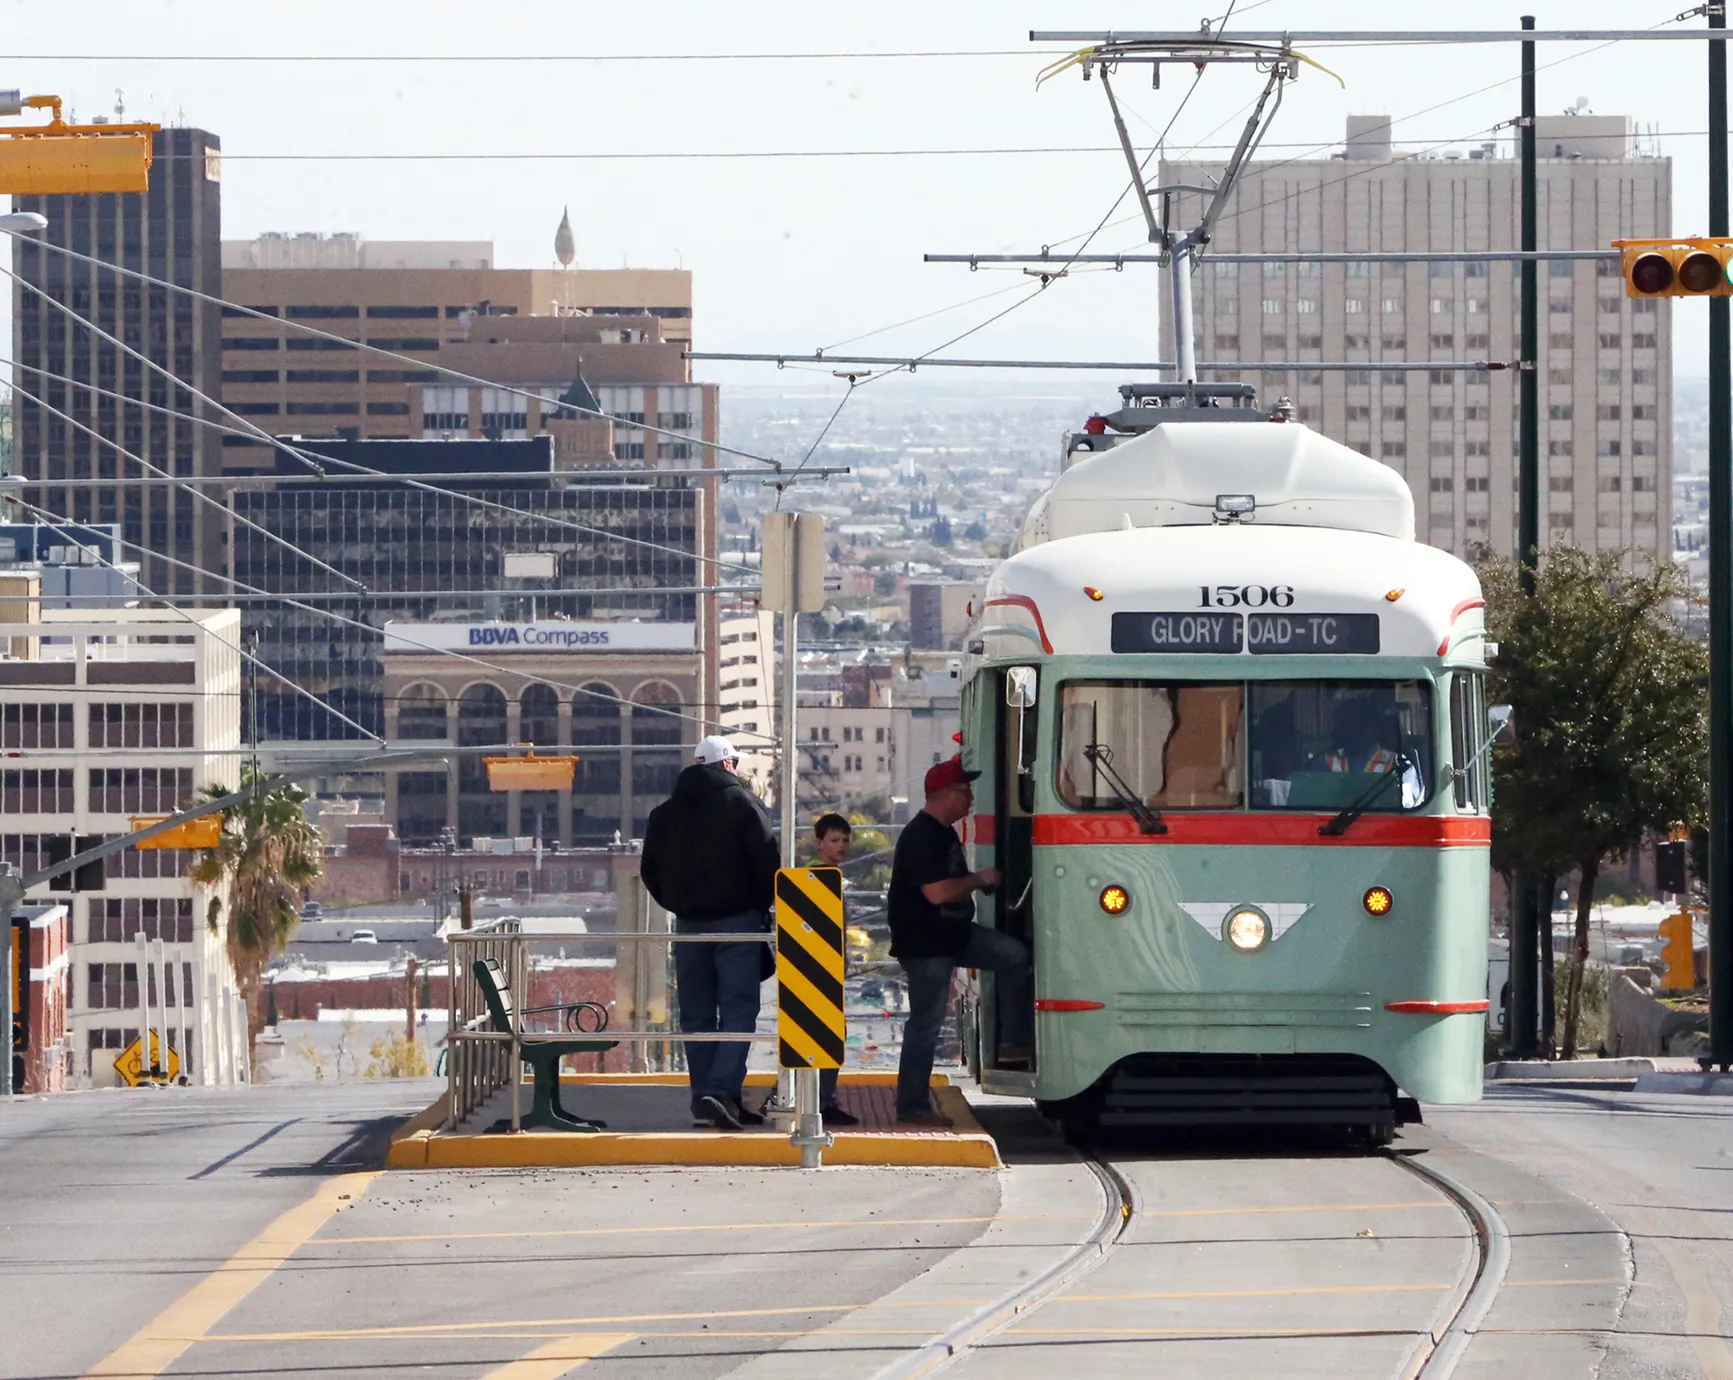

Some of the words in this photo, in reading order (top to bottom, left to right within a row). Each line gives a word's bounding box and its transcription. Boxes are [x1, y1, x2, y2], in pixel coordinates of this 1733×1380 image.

[1196, 585, 1295, 608] 1506
[469, 628, 520, 645] BBVA
[523, 627, 609, 647] Compass
[1151, 616, 1224, 644] GLORY
